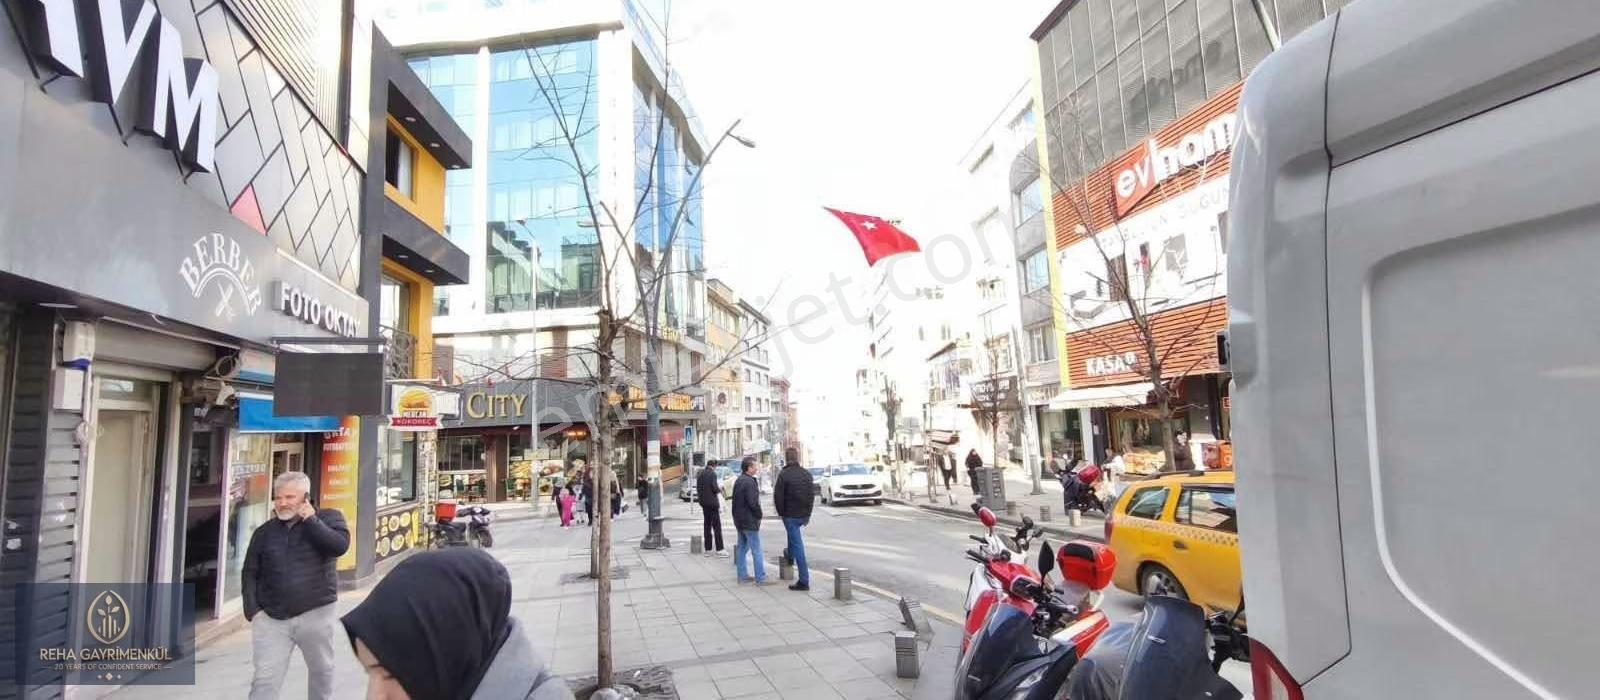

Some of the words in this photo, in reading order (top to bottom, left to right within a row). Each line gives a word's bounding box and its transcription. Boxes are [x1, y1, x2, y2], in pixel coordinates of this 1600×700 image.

[179, 232, 262, 316] BERBER
[280, 280, 321, 325] FOTO
[324, 306, 361, 338] OKTAY
[466, 391, 528, 419] CITY
